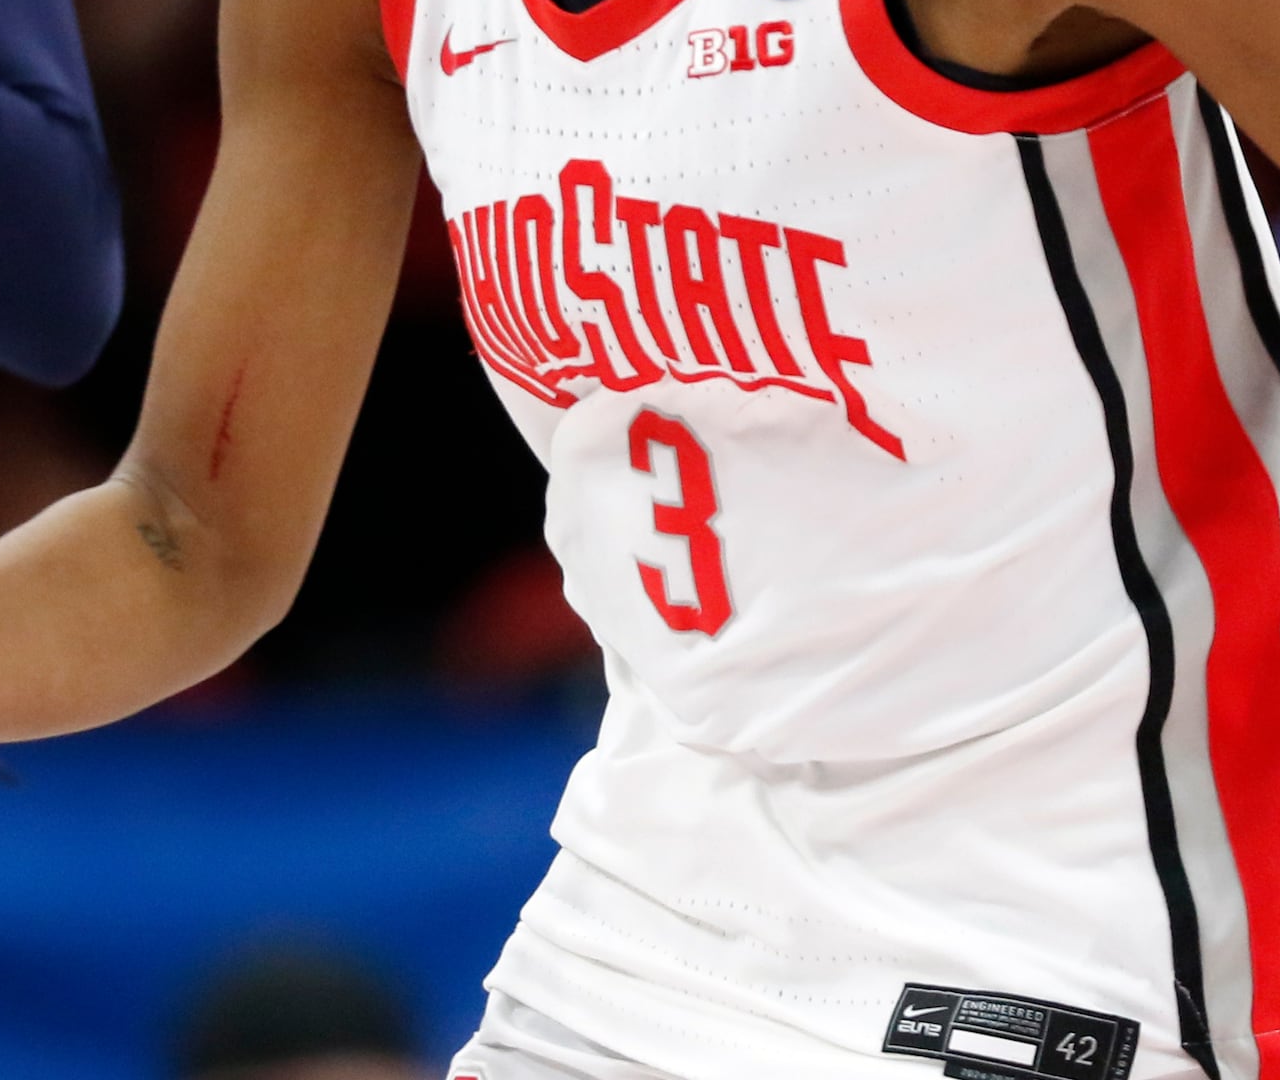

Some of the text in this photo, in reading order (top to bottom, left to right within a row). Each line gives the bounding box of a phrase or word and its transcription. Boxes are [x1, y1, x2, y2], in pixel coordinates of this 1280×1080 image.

[558, 159, 908, 462] STATE
[627, 404, 738, 642] 3
[961, 1000, 1045, 1022] ENGINEERED
[1055, 1031, 1098, 1067] 42
